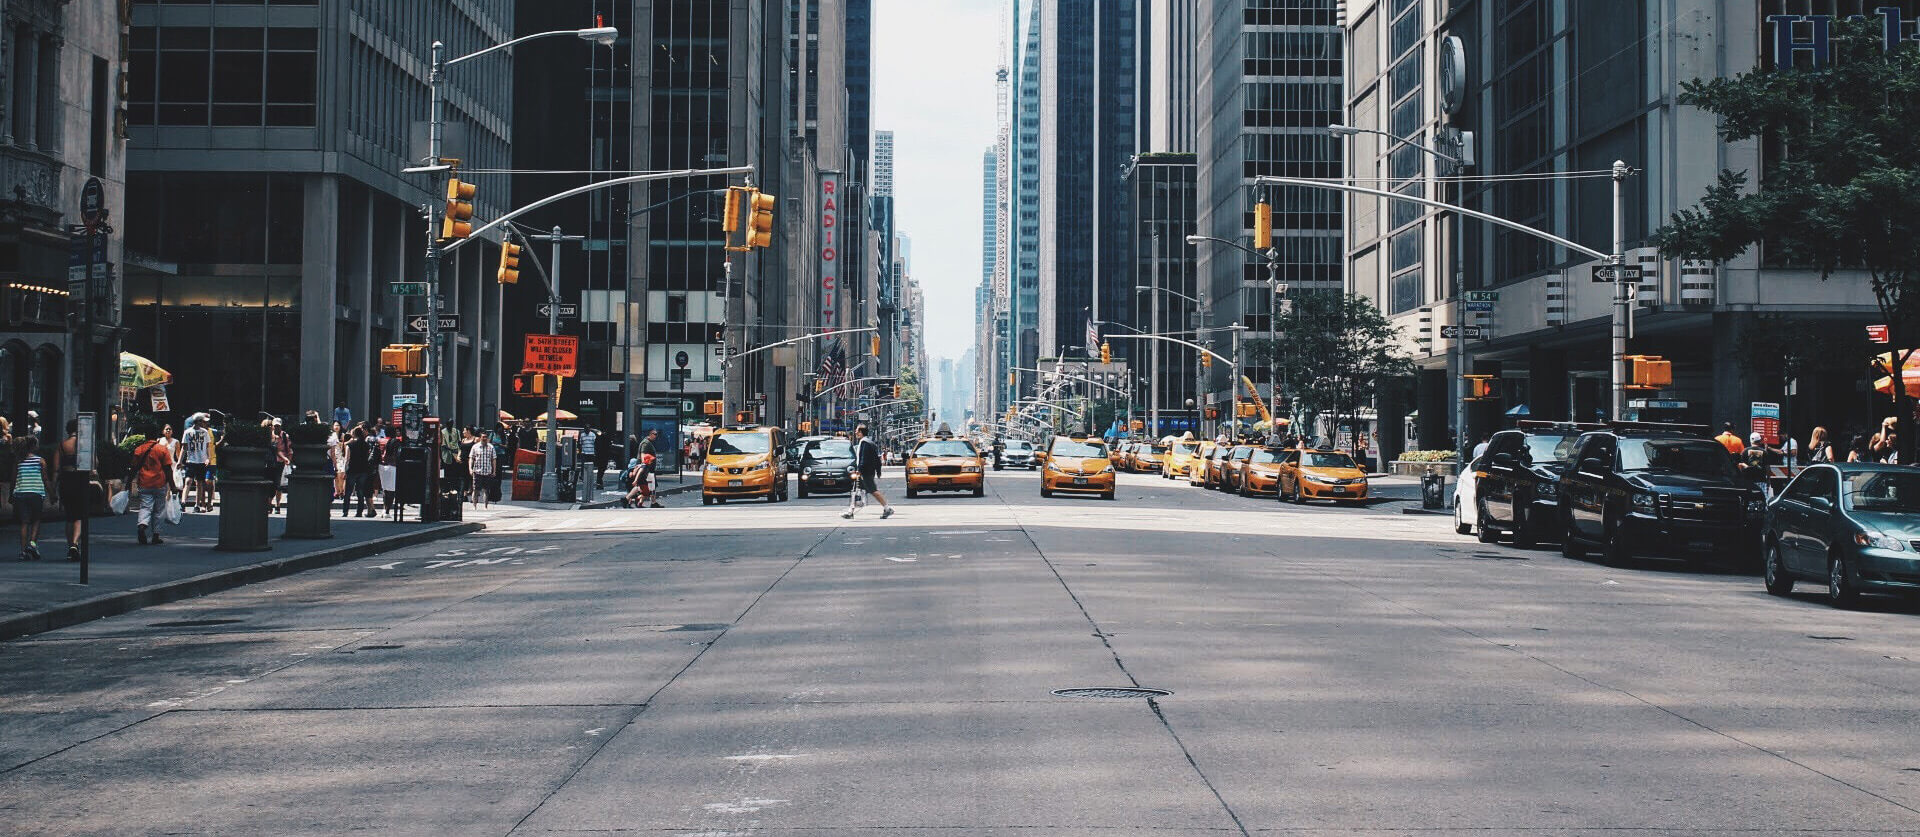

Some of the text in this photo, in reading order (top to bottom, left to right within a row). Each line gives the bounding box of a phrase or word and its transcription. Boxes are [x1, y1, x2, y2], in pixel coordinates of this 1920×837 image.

[823, 181, 836, 341] RADIO CITY
[392, 284, 399, 293] W
[400, 284, 410, 293] 54
[1481, 292, 1491, 300] 54
[554, 338, 576, 346] STREET
[538, 354, 564, 362] BETWEEN
